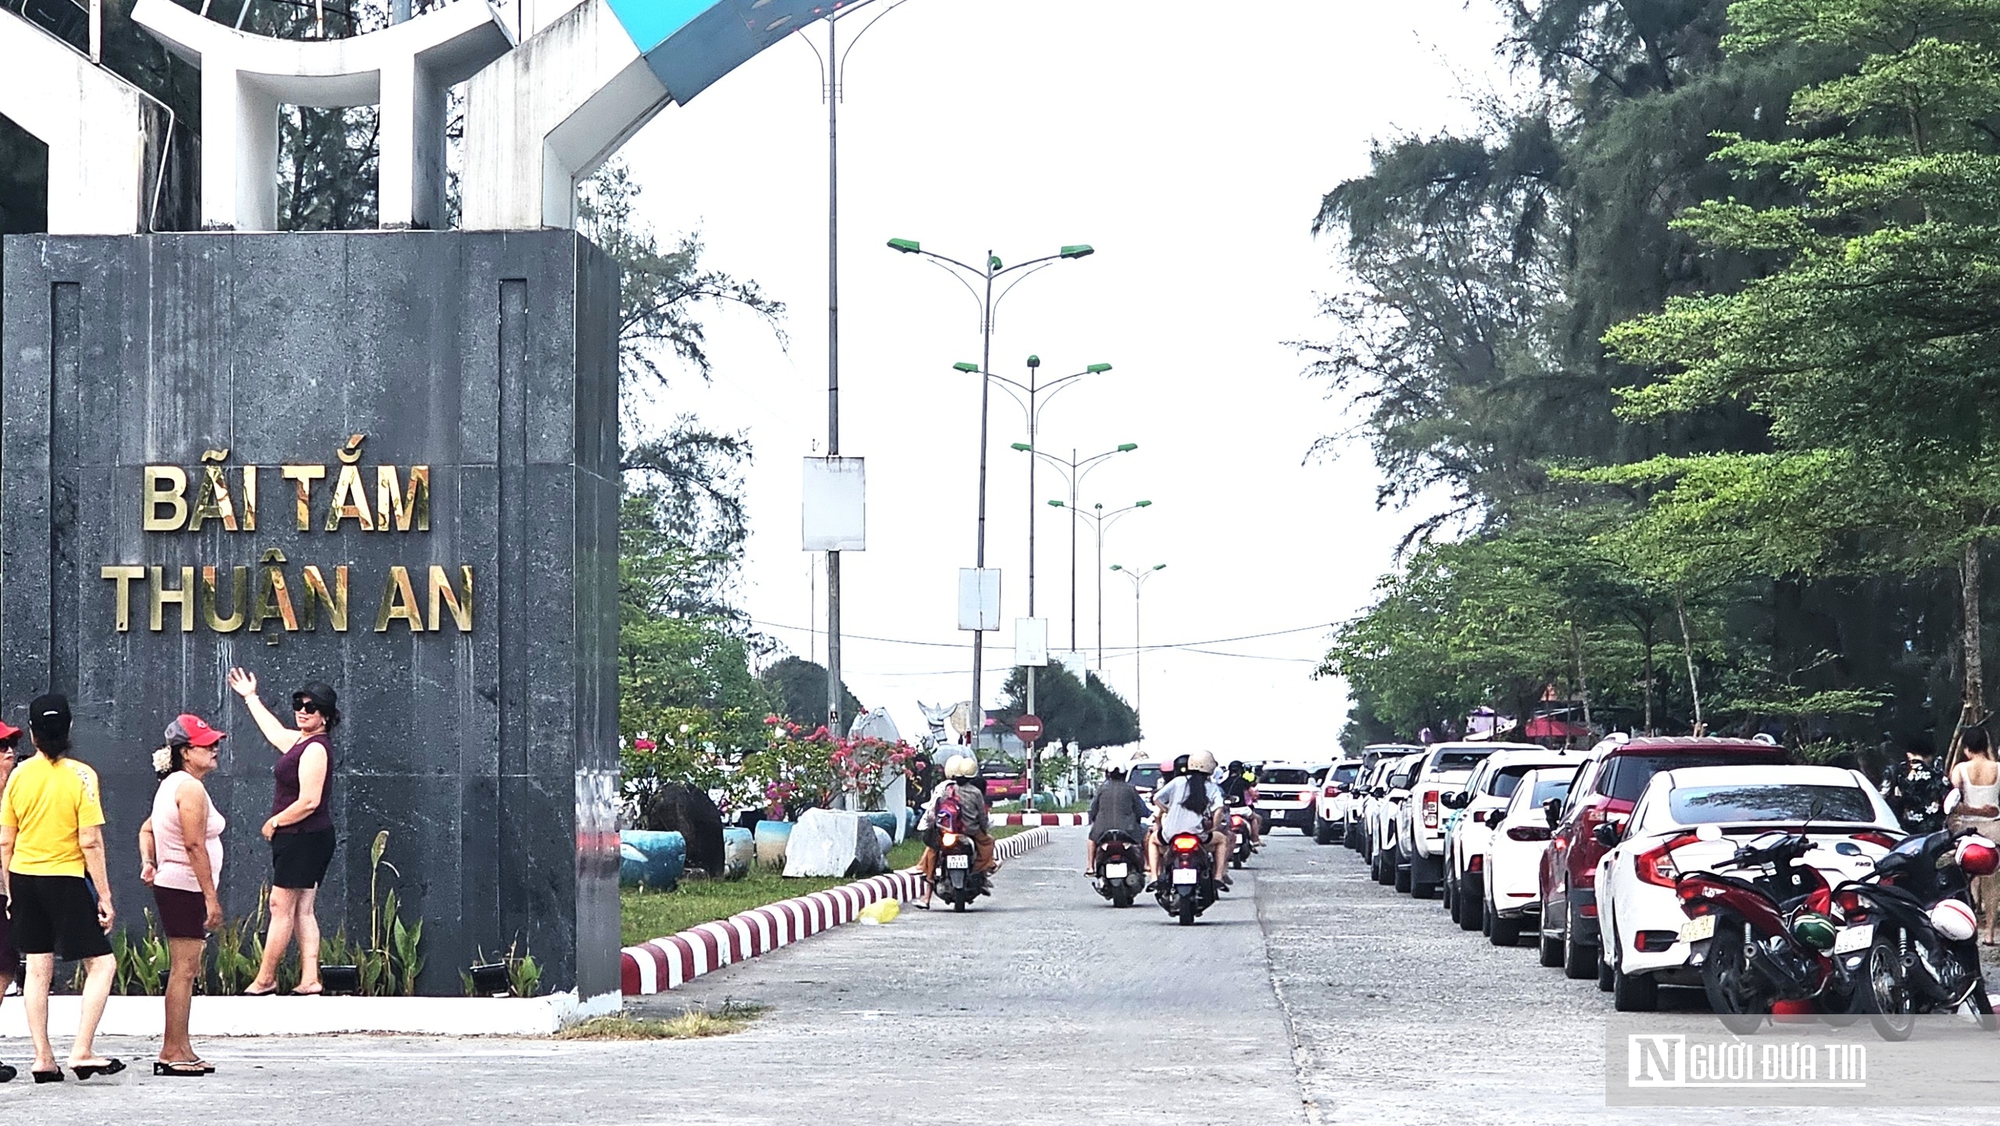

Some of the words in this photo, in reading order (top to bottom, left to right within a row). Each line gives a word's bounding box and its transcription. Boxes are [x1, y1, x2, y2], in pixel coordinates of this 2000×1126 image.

[143, 448, 256, 532] BÃI
[282, 434, 430, 532] TẮM
[100, 548, 348, 646] THUẬN
[373, 565, 473, 633] AN
